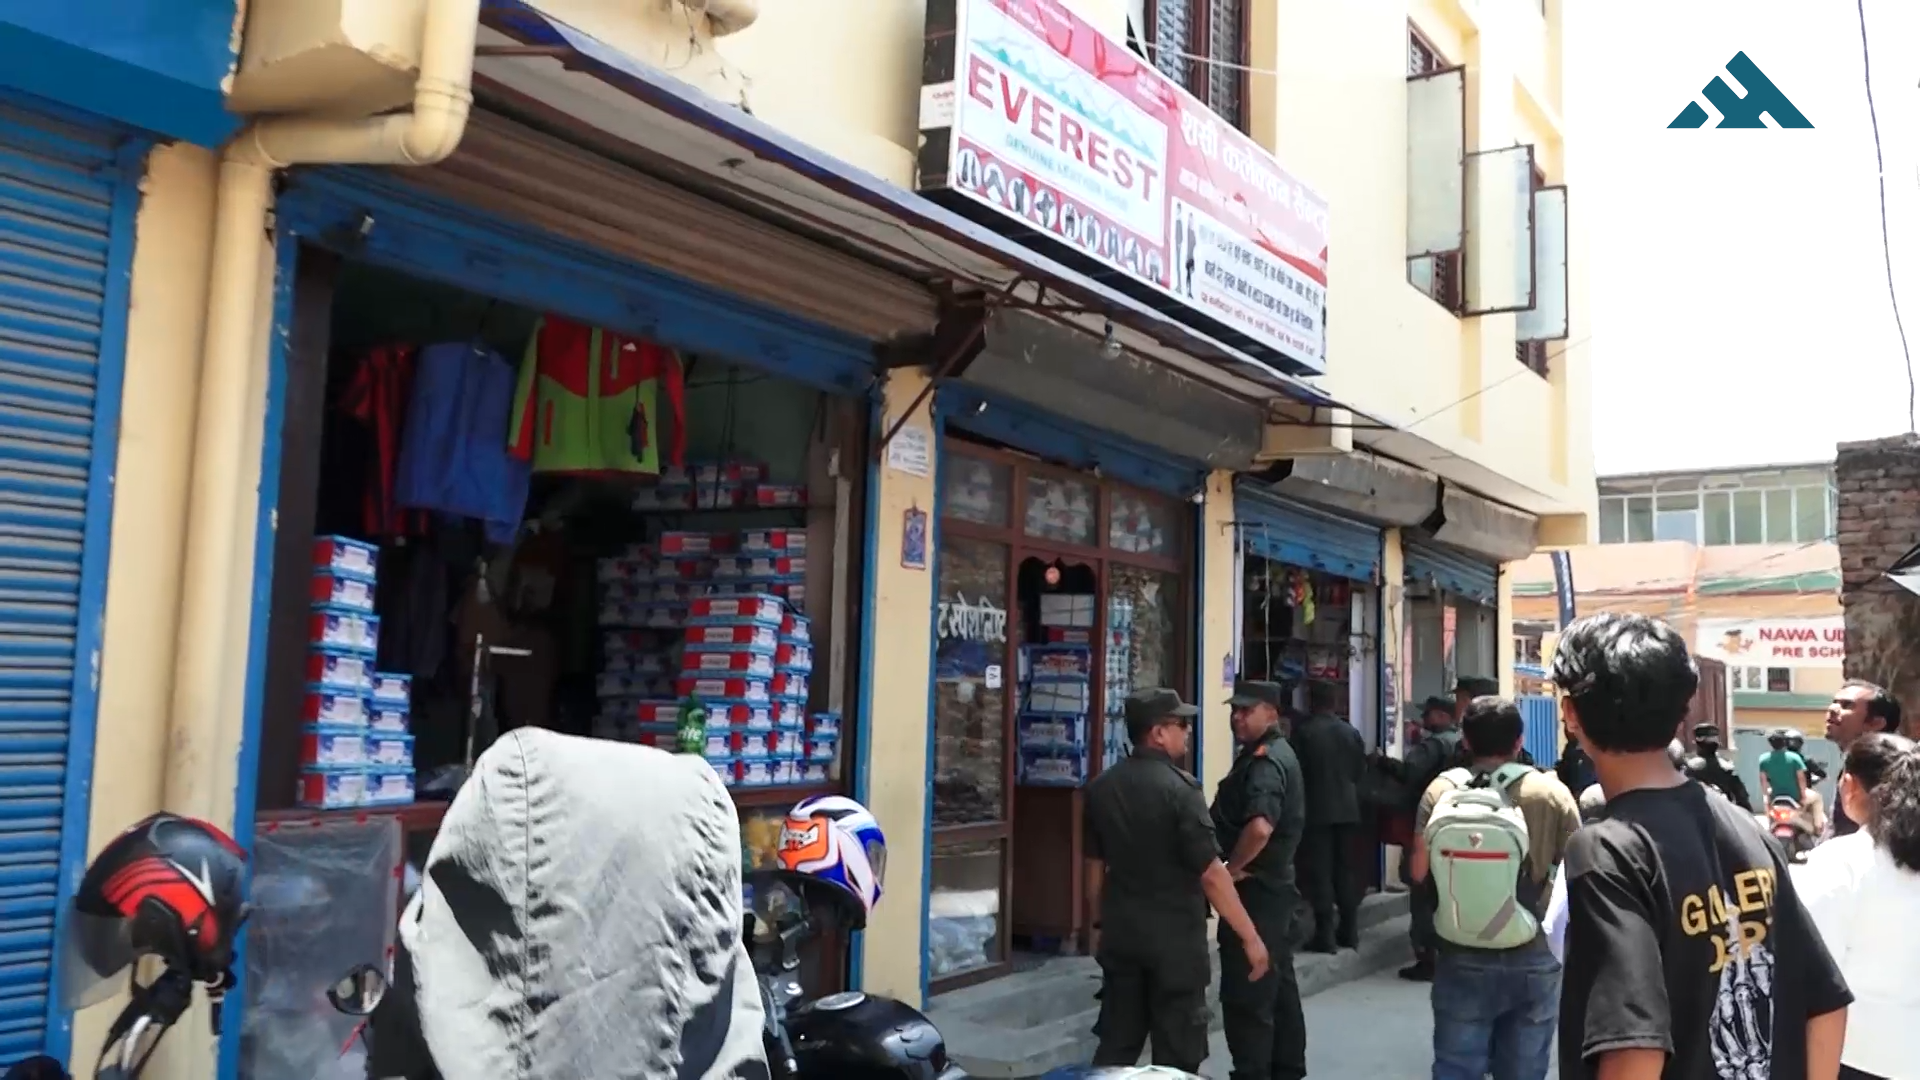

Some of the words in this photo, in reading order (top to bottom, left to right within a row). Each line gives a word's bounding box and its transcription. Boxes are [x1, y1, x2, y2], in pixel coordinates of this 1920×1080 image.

[969, 53, 1158, 202] EVEREST
[1759, 628, 1817, 642] NAWA
[1773, 646, 1804, 658] PRE
[1809, 647, 1845, 658] SCH
